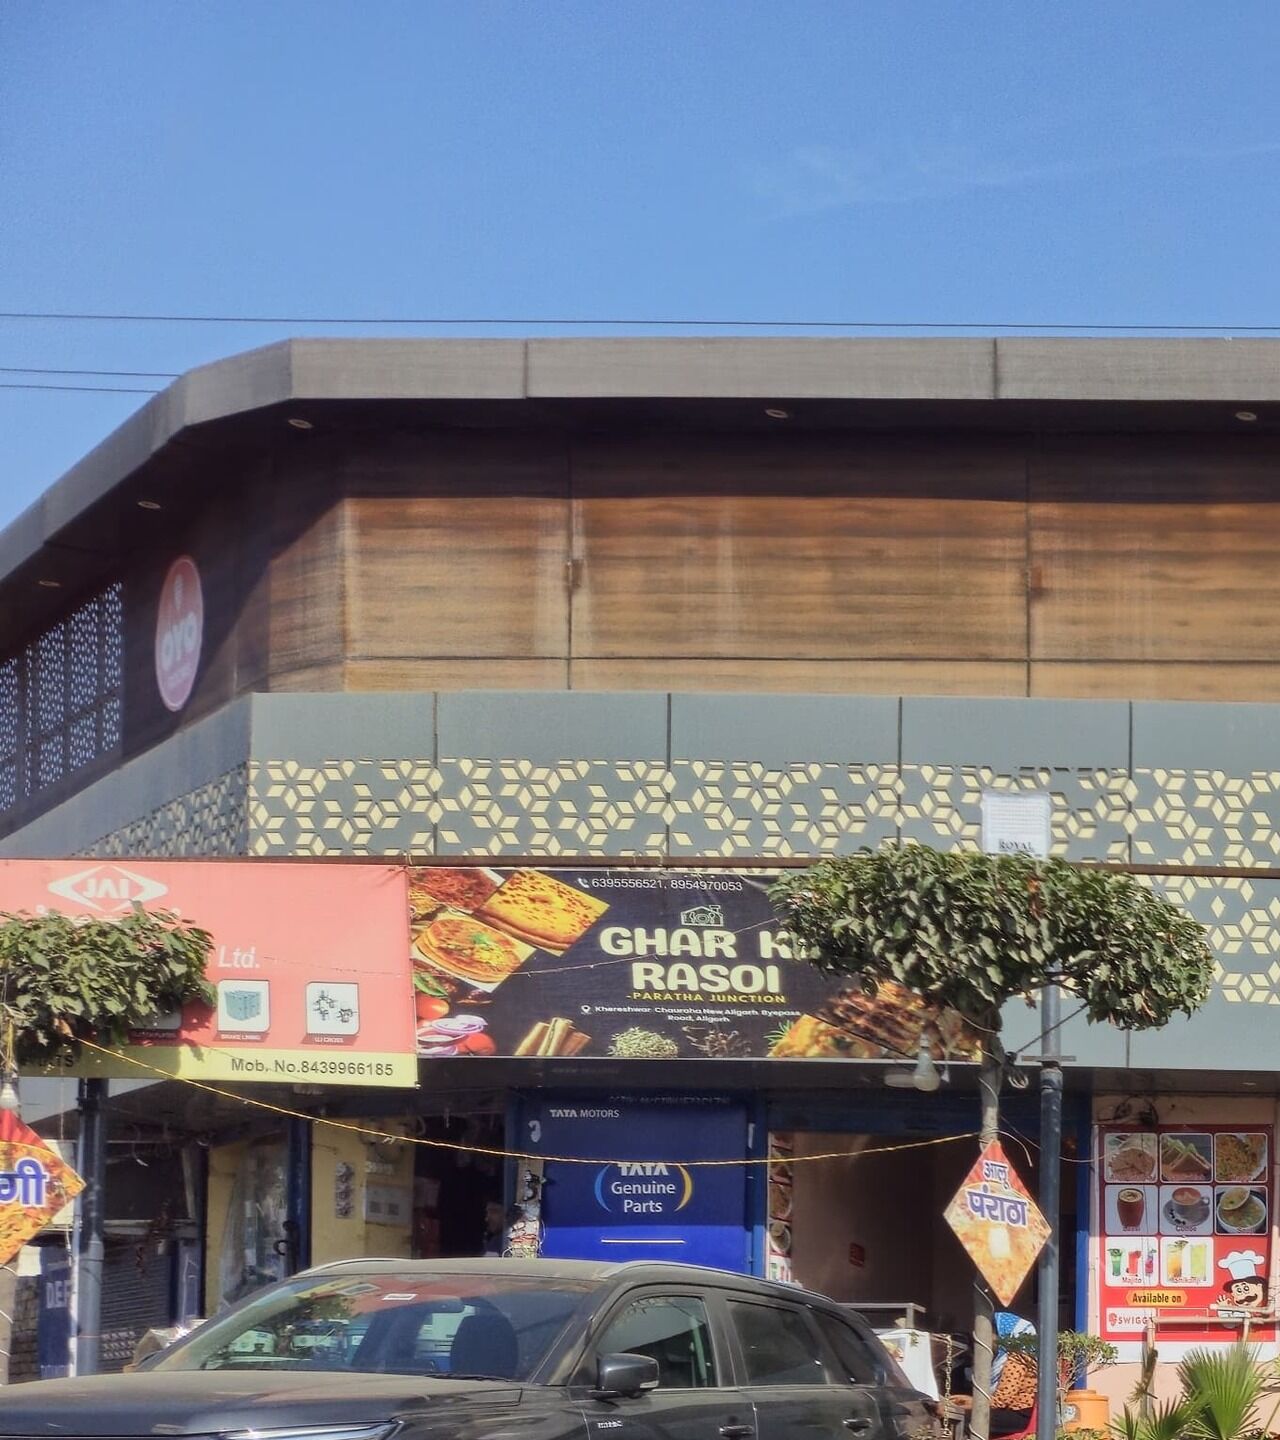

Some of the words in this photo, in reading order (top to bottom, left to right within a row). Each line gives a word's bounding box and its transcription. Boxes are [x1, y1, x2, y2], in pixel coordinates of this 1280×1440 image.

[82, 878, 130, 899] JAI
[670, 879, 743, 891] 8954970053
[600, 926, 737, 958] GHAR
[759, 930, 807, 959] K
[217, 946, 260, 969] Ltd.
[632, 962, 781, 993] RASOI
[709, 994, 786, 1004] JUNCTION
[231, 1058, 269, 1072] Mob.
[550, 1109, 577, 1118] TATA
[579, 1109, 620, 1118] MOTORS
[617, 1163, 669, 1177] TATA
[984, 1162, 1009, 1189] आलू
[611, 1181, 676, 1194] Genuine
[623, 1199, 663, 1213] Parts
[1132, 1293, 1170, 1303] Available
[1171, 1295, 1182, 1303] on
